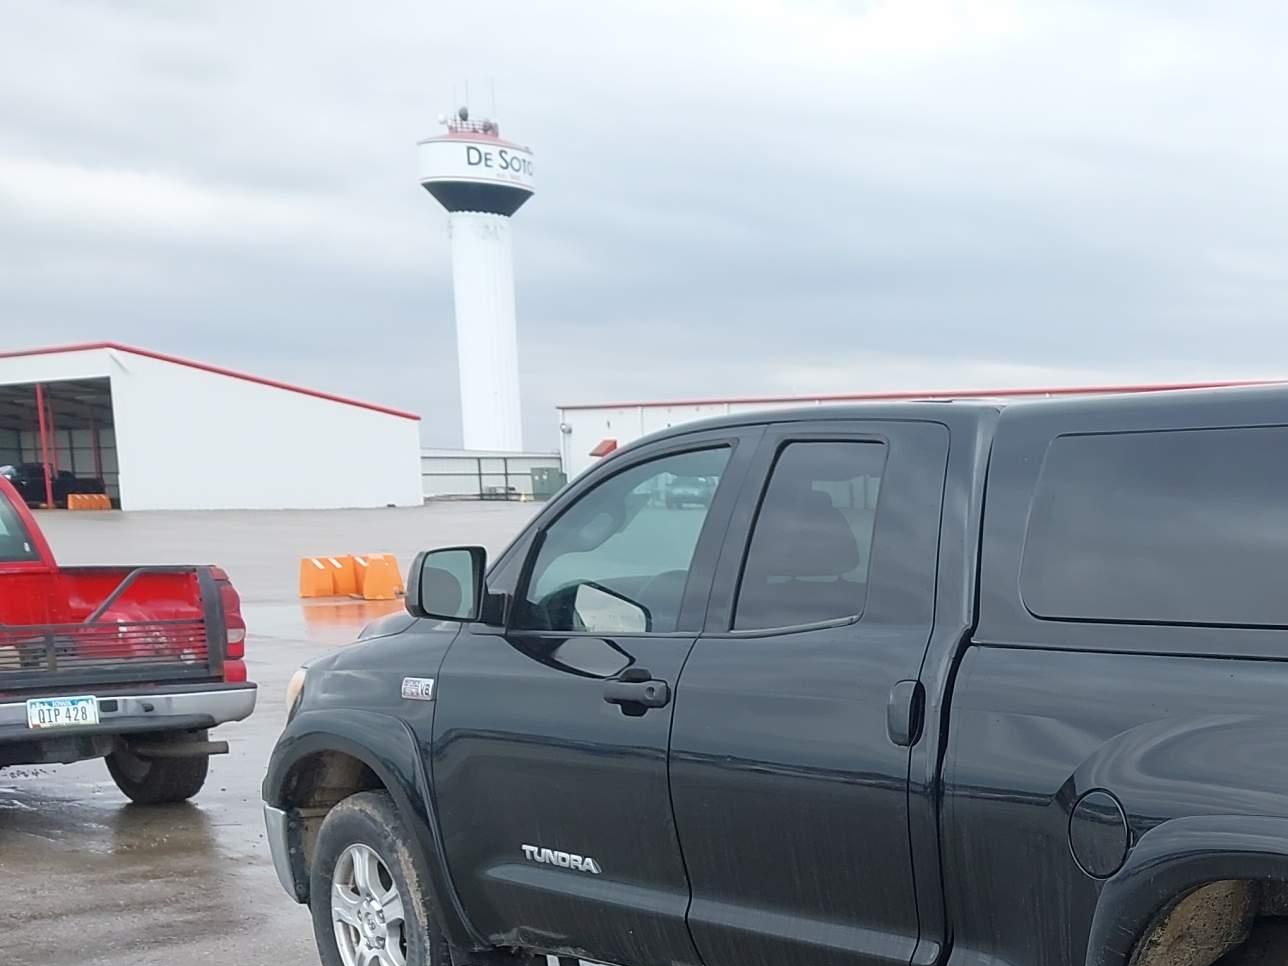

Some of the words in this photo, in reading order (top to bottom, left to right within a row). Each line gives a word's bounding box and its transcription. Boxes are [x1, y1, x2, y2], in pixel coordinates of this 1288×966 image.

[38, 707, 60, 723] QIP
[65, 705, 88, 722] 428
[521, 844, 602, 874] TUNDRA
